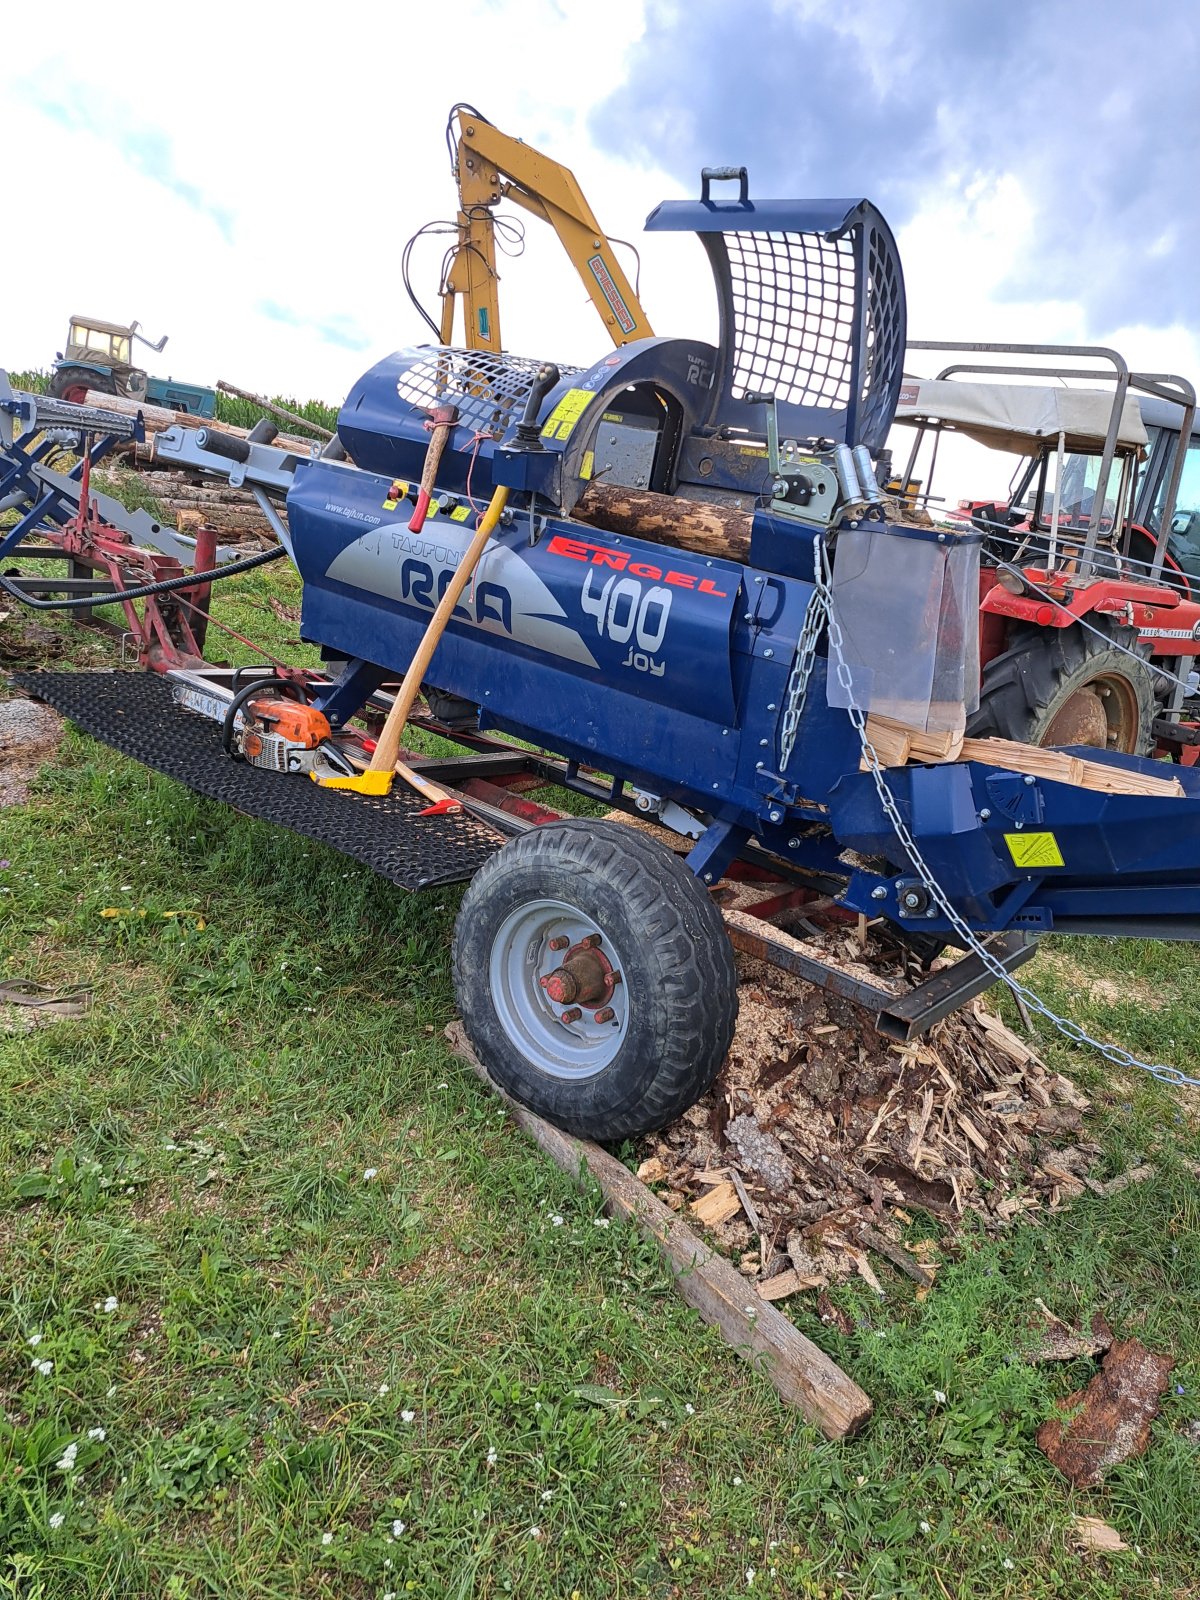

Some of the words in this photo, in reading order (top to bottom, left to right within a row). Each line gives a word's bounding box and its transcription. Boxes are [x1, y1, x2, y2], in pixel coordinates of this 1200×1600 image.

[325, 503, 381, 525] www.tajfun.com
[391, 532, 460, 566] TAJFUN
[547, 536, 727, 598] ENGEL
[581, 567, 673, 653] 400
